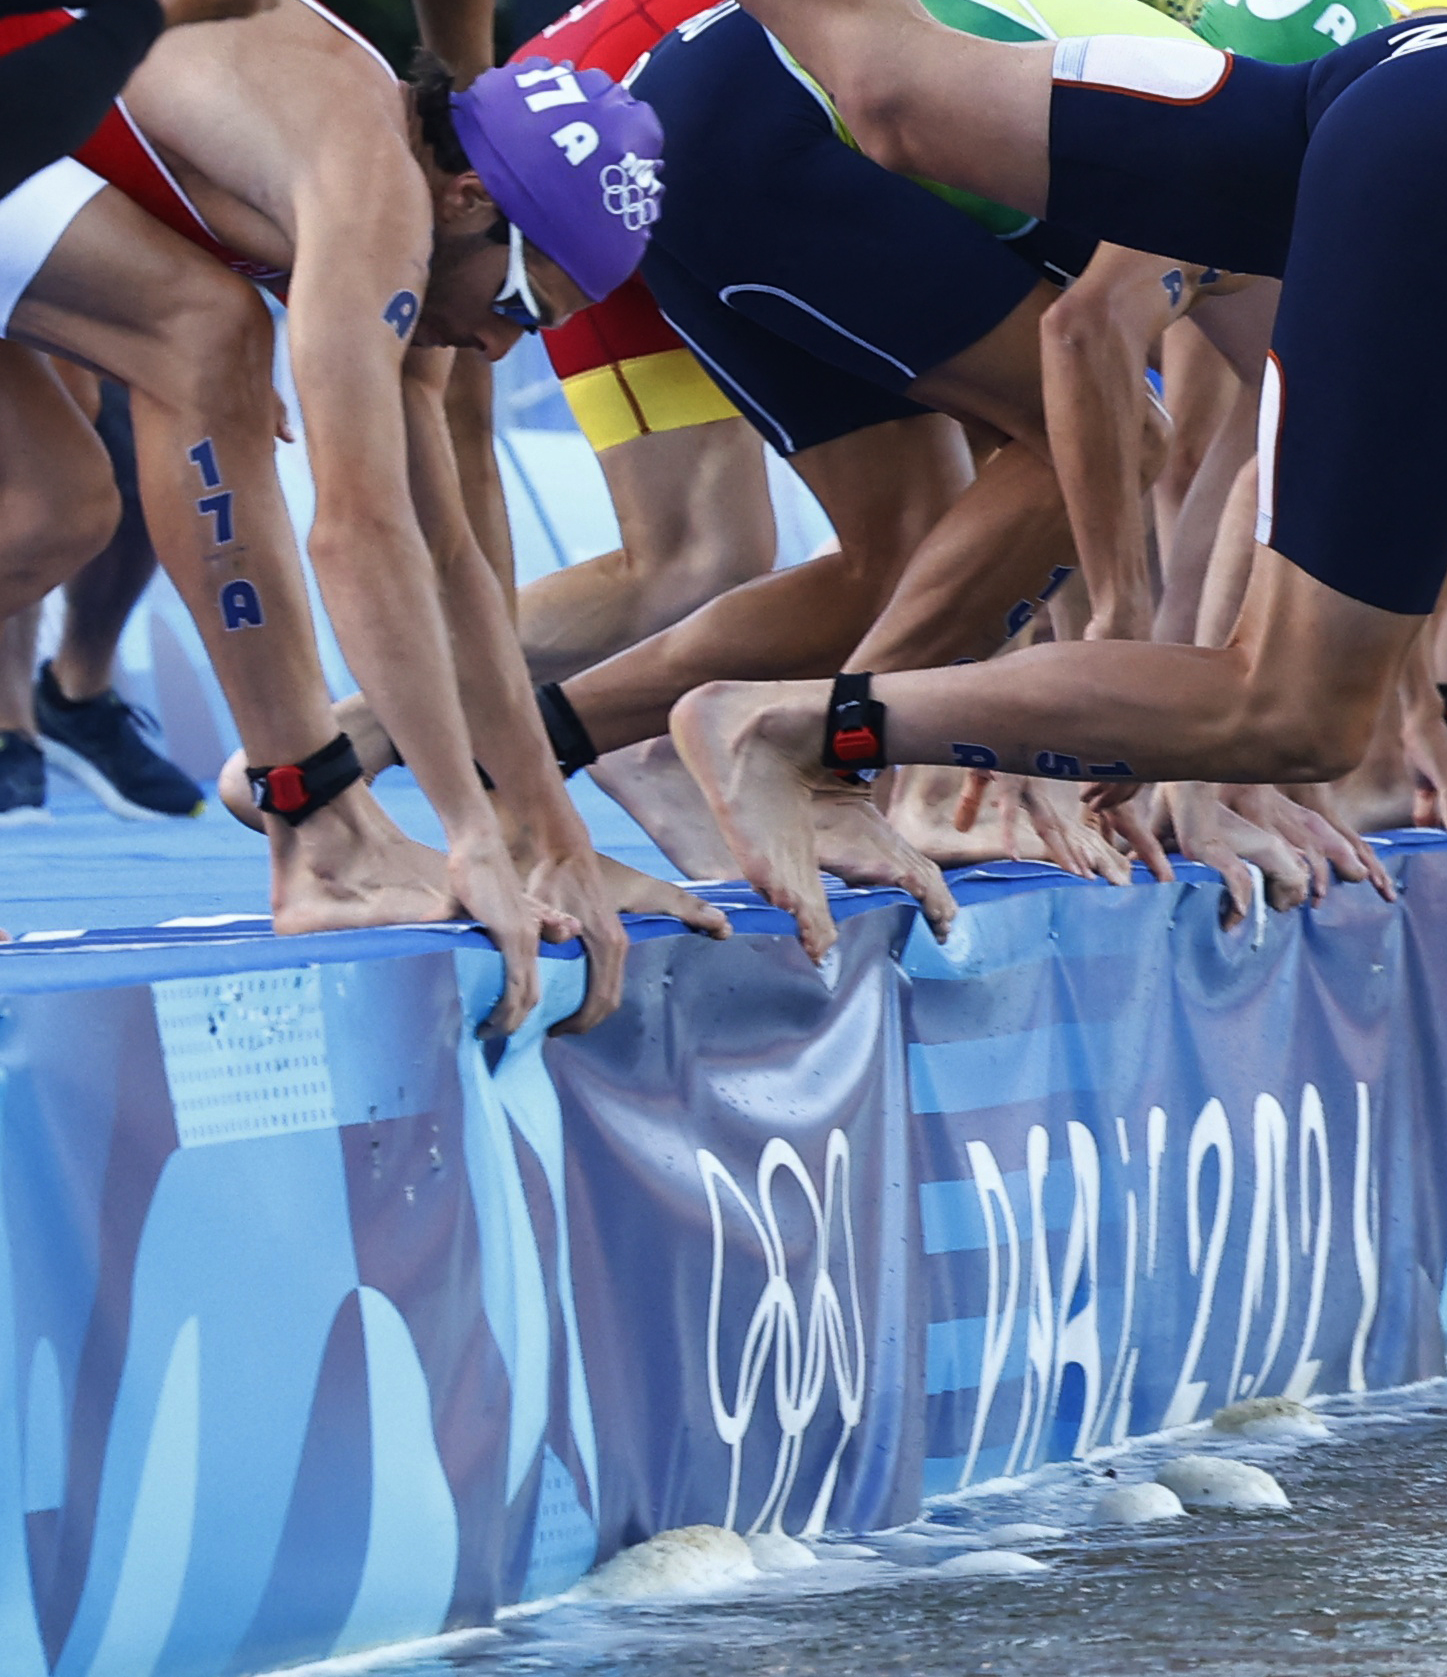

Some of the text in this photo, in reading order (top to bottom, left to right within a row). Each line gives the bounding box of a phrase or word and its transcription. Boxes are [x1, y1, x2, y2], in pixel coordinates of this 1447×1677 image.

[1312, 2, 1357, 48] A
[514, 66, 590, 114] 17
[550, 121, 600, 167] A
[380, 289, 420, 342] A
[218, 578, 266, 633] A
[957, 1102, 1169, 1492] PARIS
